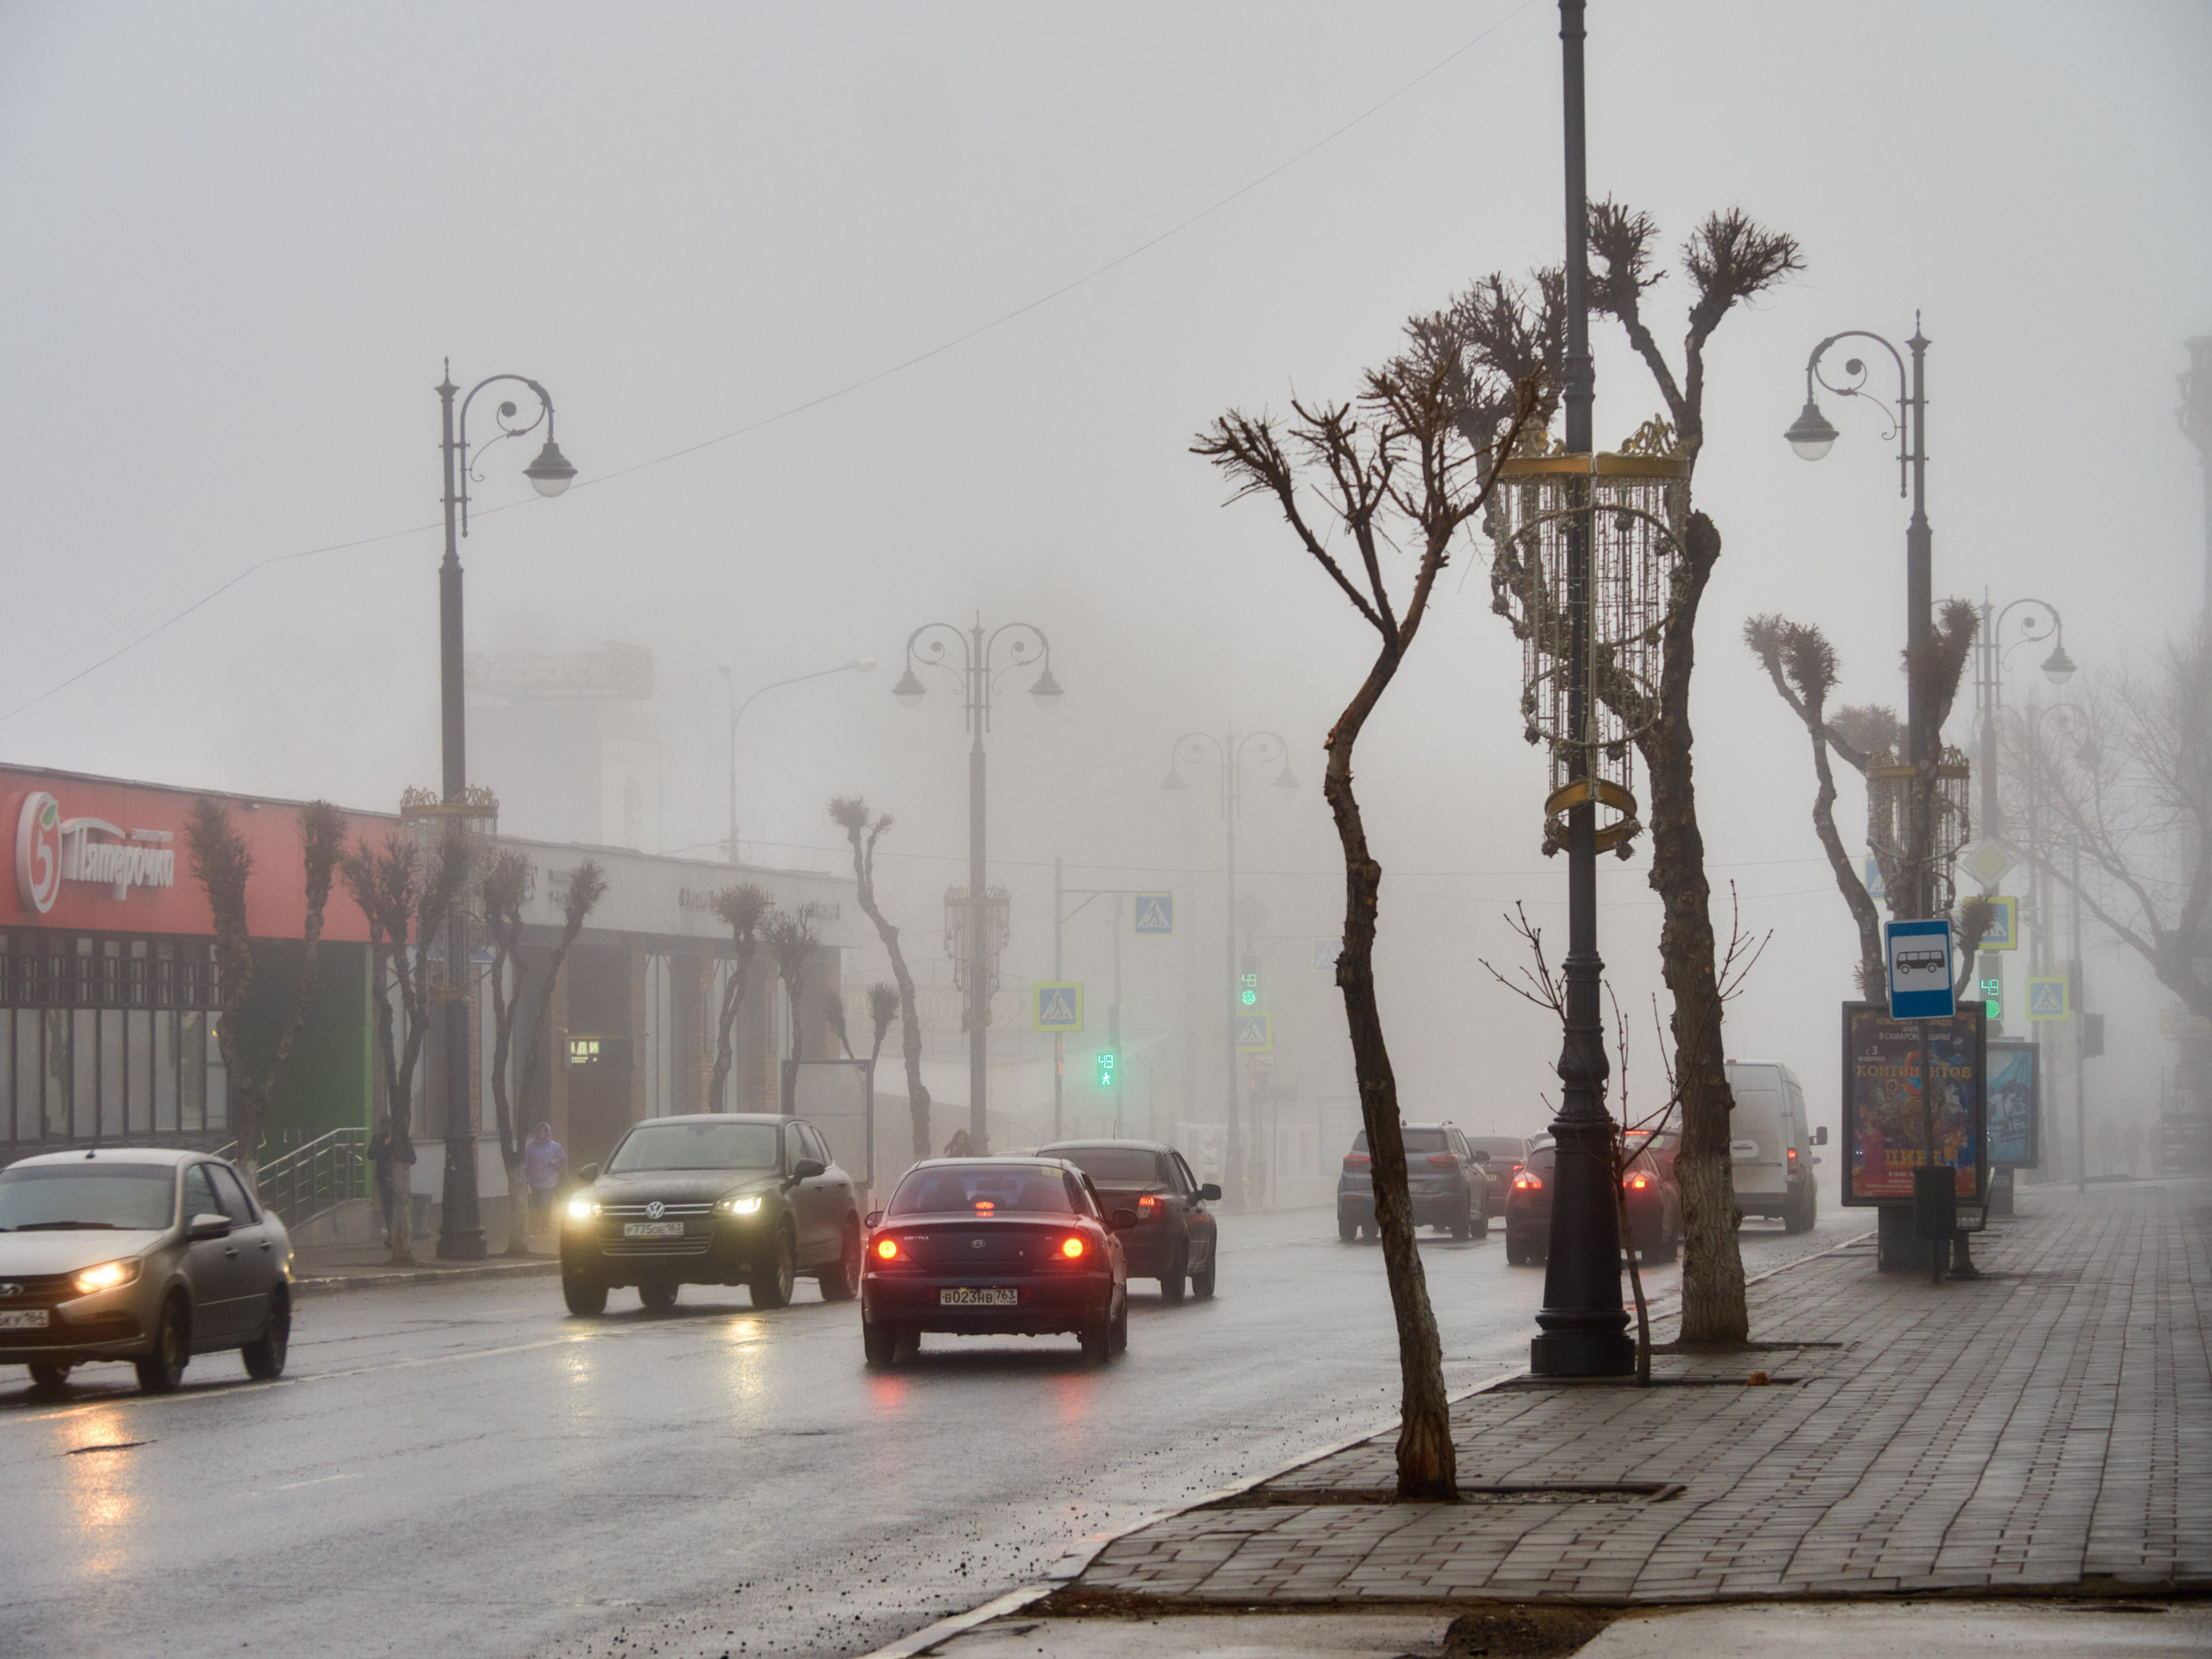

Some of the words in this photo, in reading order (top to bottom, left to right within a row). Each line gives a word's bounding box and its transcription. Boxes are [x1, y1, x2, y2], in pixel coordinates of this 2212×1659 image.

[1242, 974, 1255, 987] 49
[1981, 979, 1999, 995] 49
[1098, 1054, 1114, 1068] 49
[1857, 1065, 1972, 1078] КОНТИННТОВ
